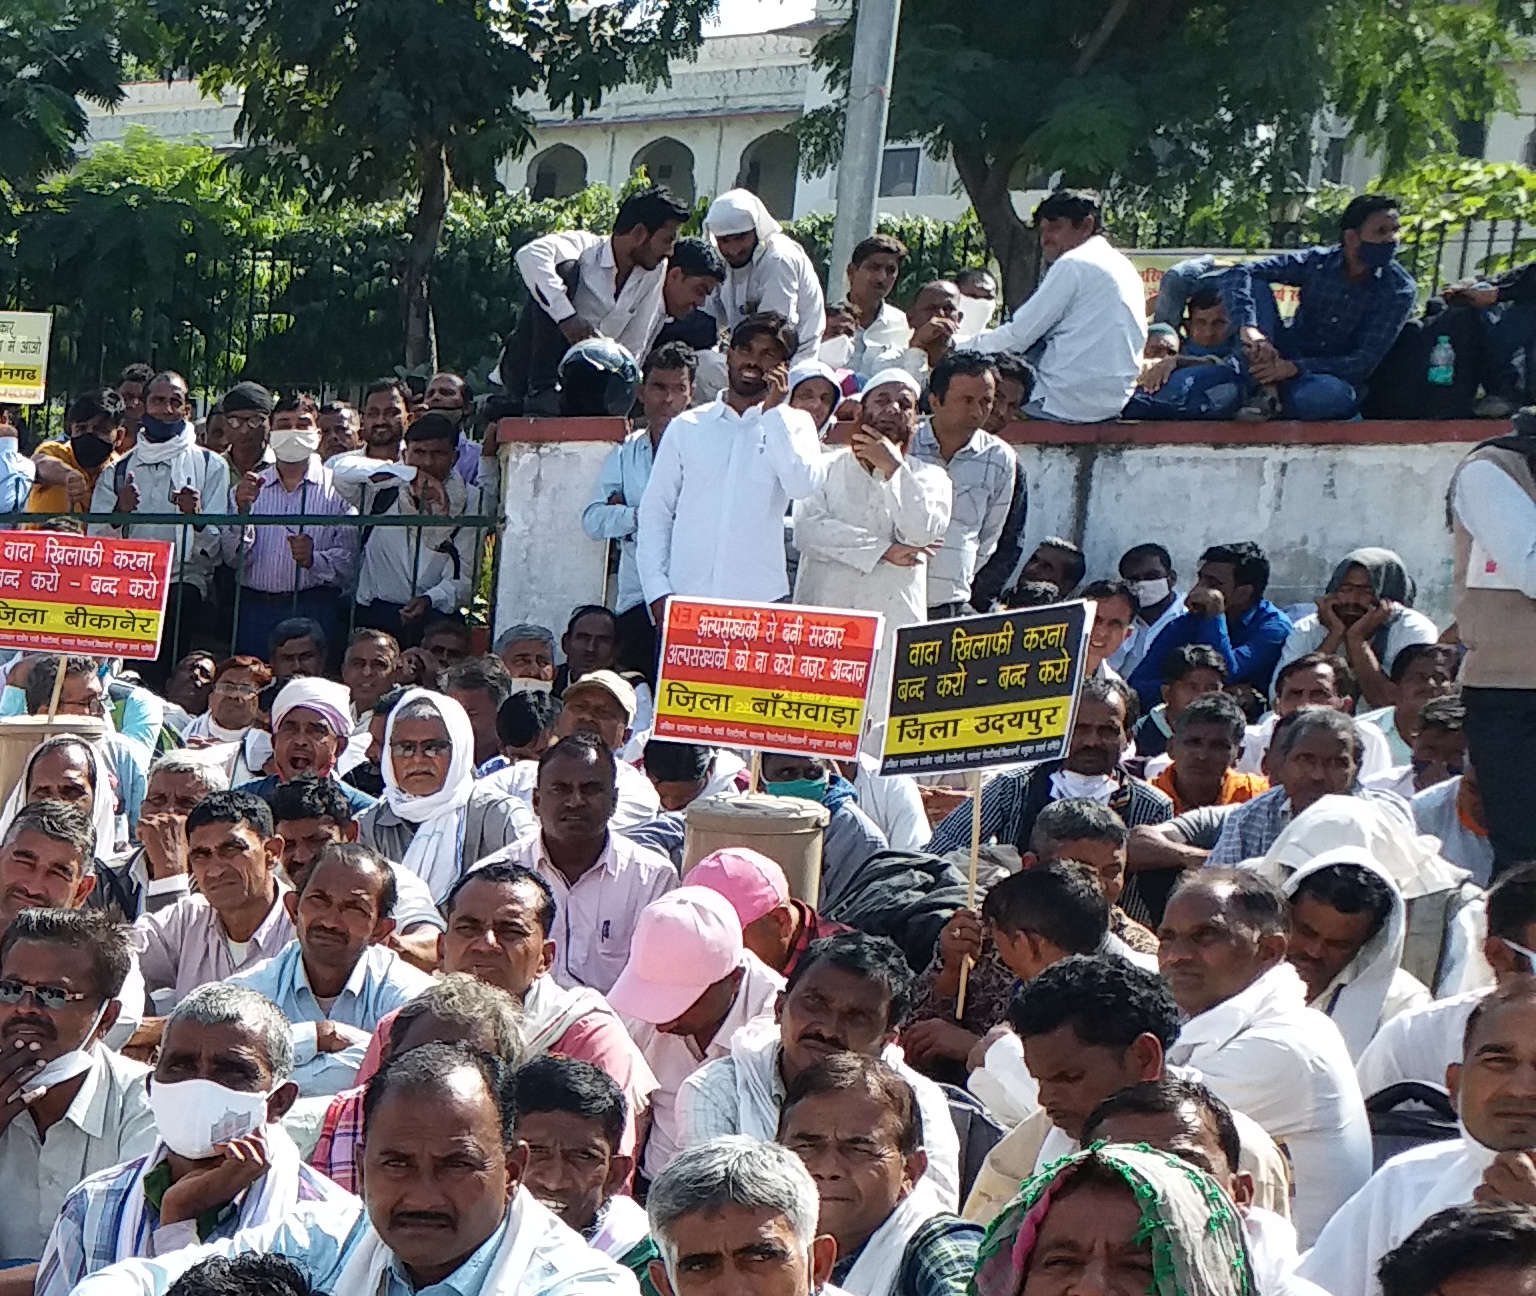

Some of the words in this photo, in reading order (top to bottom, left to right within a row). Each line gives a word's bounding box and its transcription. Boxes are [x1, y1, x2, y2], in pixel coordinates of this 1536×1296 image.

[8, 335, 16, 353] में
[20, 336, 42, 355] आओ
[4, 541, 36, 562] वादा
[44, 536, 105, 568] खिलाफी
[113, 549, 156, 572] करना
[31, 565, 61, 592] करो
[90, 575, 121, 597] बन्द
[129, 572, 159, 600] करो
[64, 607, 155, 633] बीकानेर
[766, 613, 777, 643] से
[783, 615, 804, 646] बनी
[809, 625, 846, 649] सरकार
[735, 642, 750, 672] को
[755, 651, 769, 674] ना
[774, 645, 795, 676] करो
[909, 640, 943, 667] वादा
[950, 621, 1014, 662] खिलाफी
[1023, 623, 1070, 652] करना
[897, 677, 928, 702] बन्द
[936, 662, 968, 697] करो
[997, 663, 1030, 690] बन्द
[1038, 648, 1072, 685] करो
[751, 692, 860, 729] बाँसवाड़ा
[973, 706, 1061, 735] उदयपुर
